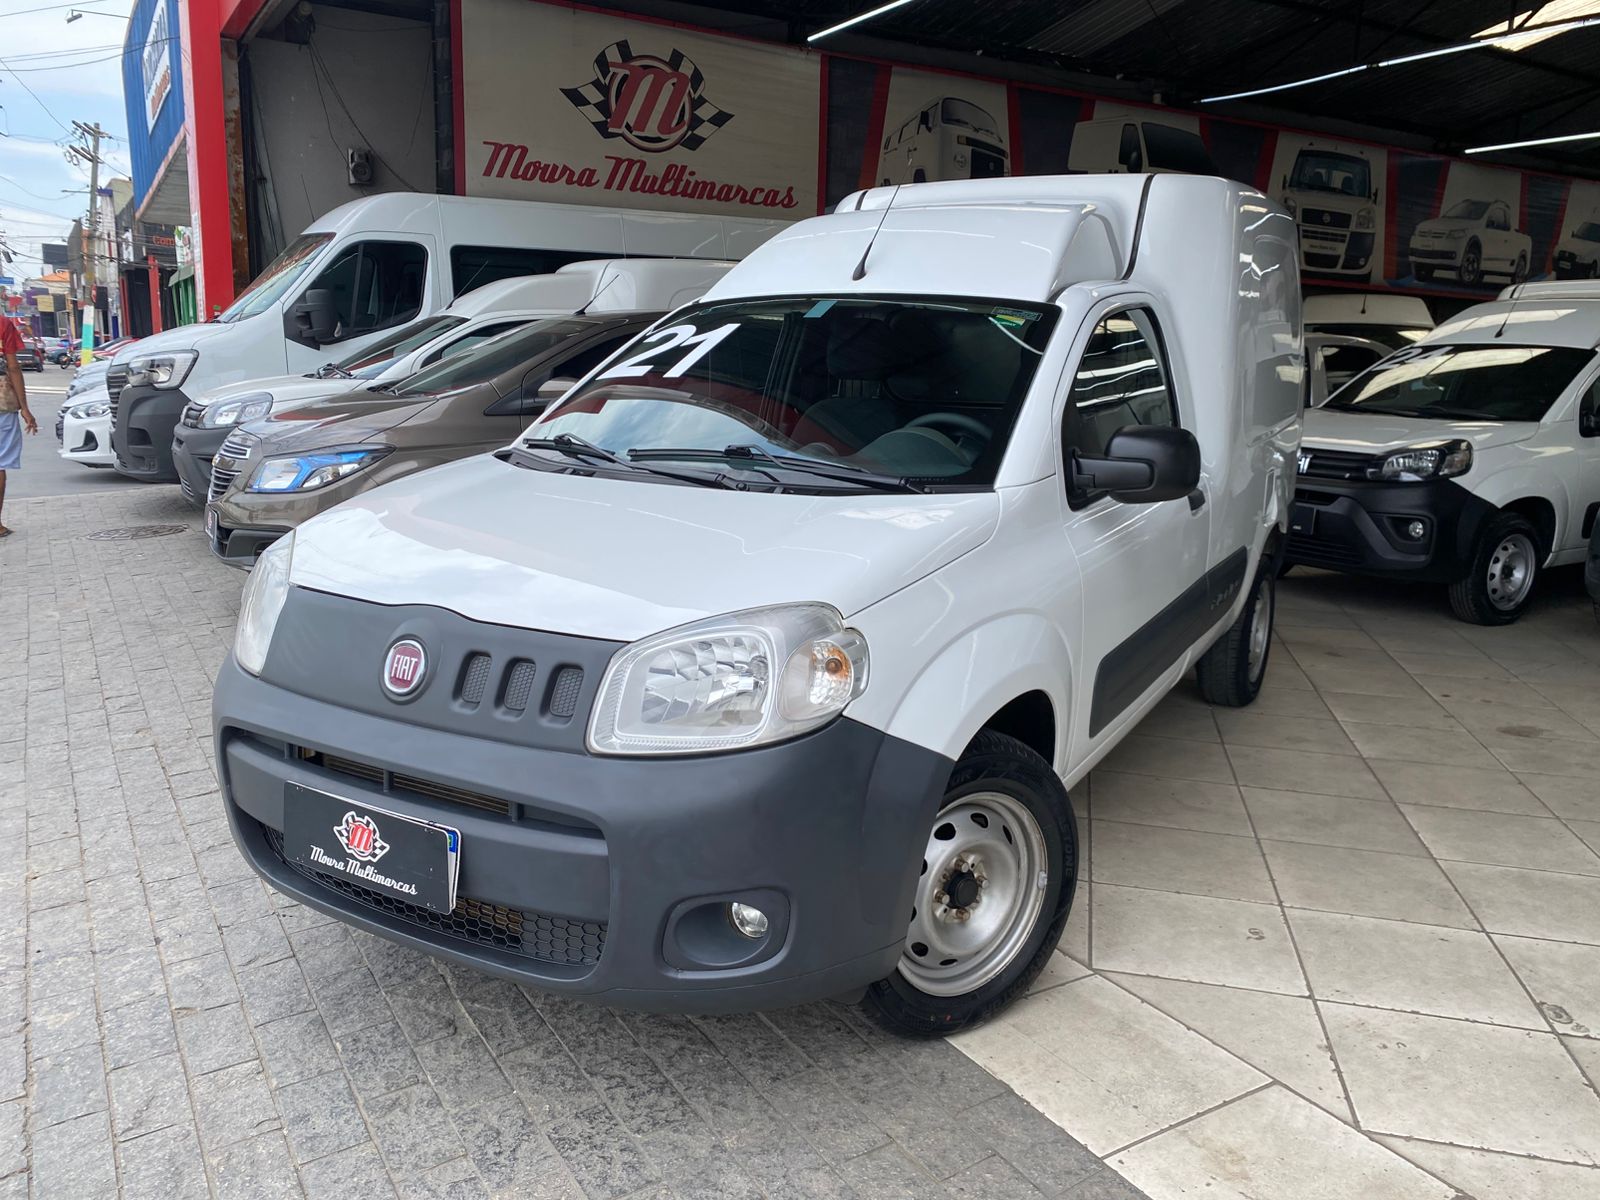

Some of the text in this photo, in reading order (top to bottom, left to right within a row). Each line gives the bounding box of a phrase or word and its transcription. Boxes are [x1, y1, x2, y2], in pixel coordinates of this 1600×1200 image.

[483, 141, 798, 209] Moura Multimarcas
[595, 323, 741, 381] 21
[391, 654, 417, 682] FIAT
[310, 845, 418, 895] Moura Multimarcas
